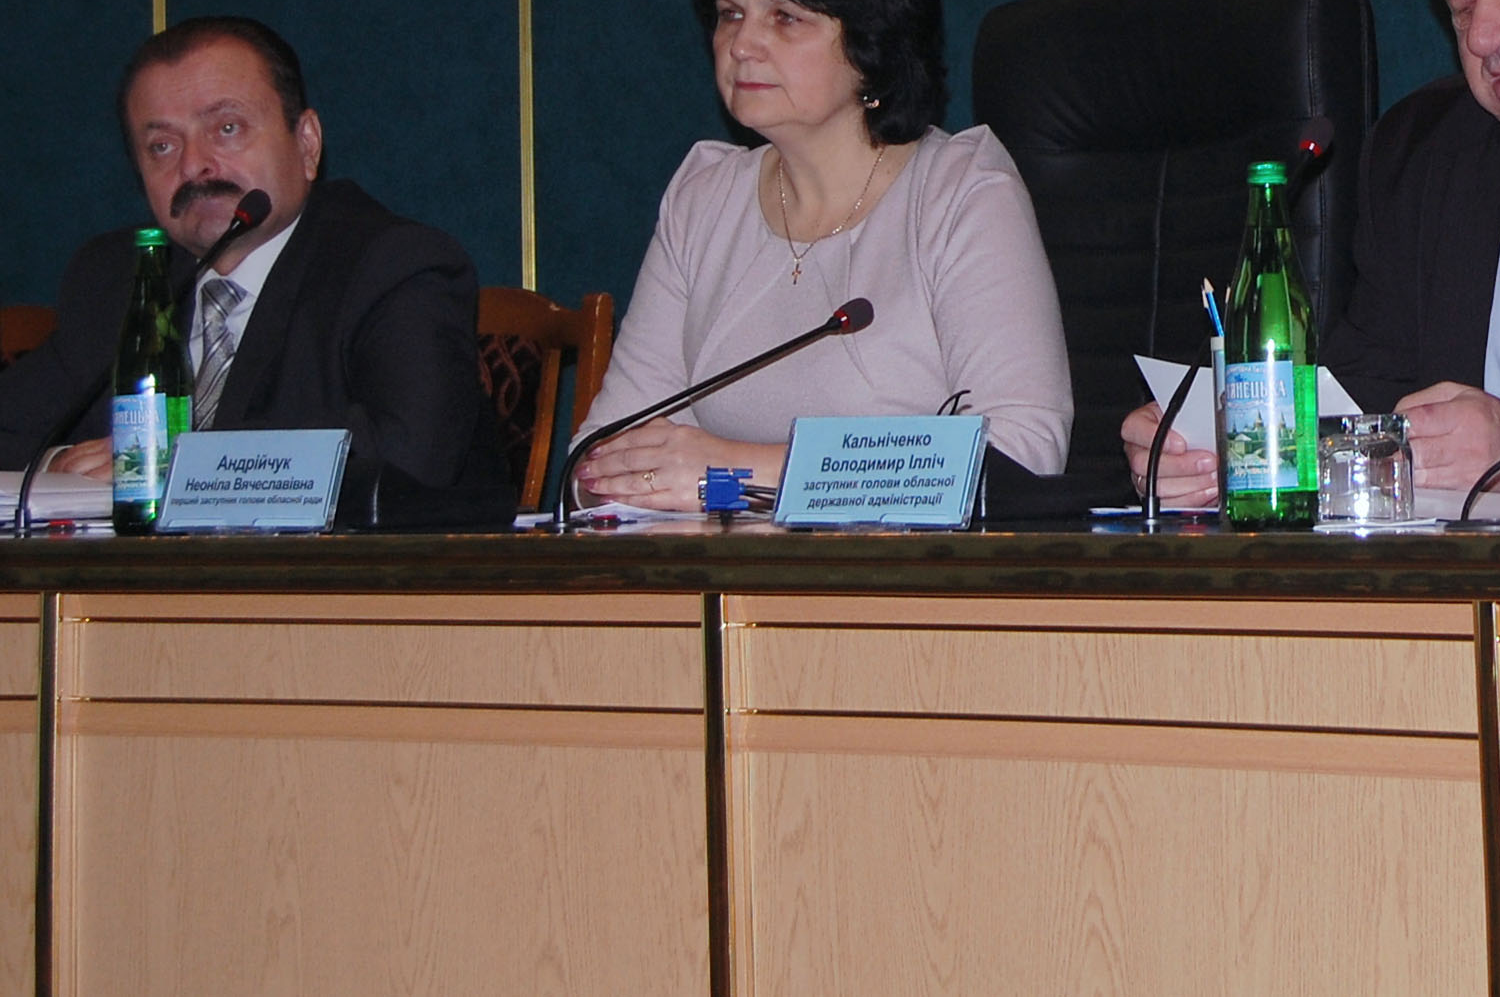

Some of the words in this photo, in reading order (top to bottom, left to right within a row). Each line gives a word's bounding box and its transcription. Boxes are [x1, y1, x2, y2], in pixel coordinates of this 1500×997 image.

[842, 432, 932, 449] Кальніченко
[216, 454, 292, 473] Андрійчук
[821, 455, 905, 473] Володимир
[909, 453, 945, 470] Ілліч
[185, 477, 230, 491] Неоніла
[232, 476, 314, 491] Вячеславівна
[803, 480, 858, 493] заступник
[860, 478, 900, 489] голови
[903, 474, 956, 488] обласної
[303, 496, 323, 506] ради
[807, 497, 866, 511] державної
[867, 493, 944, 507] адміністрації
